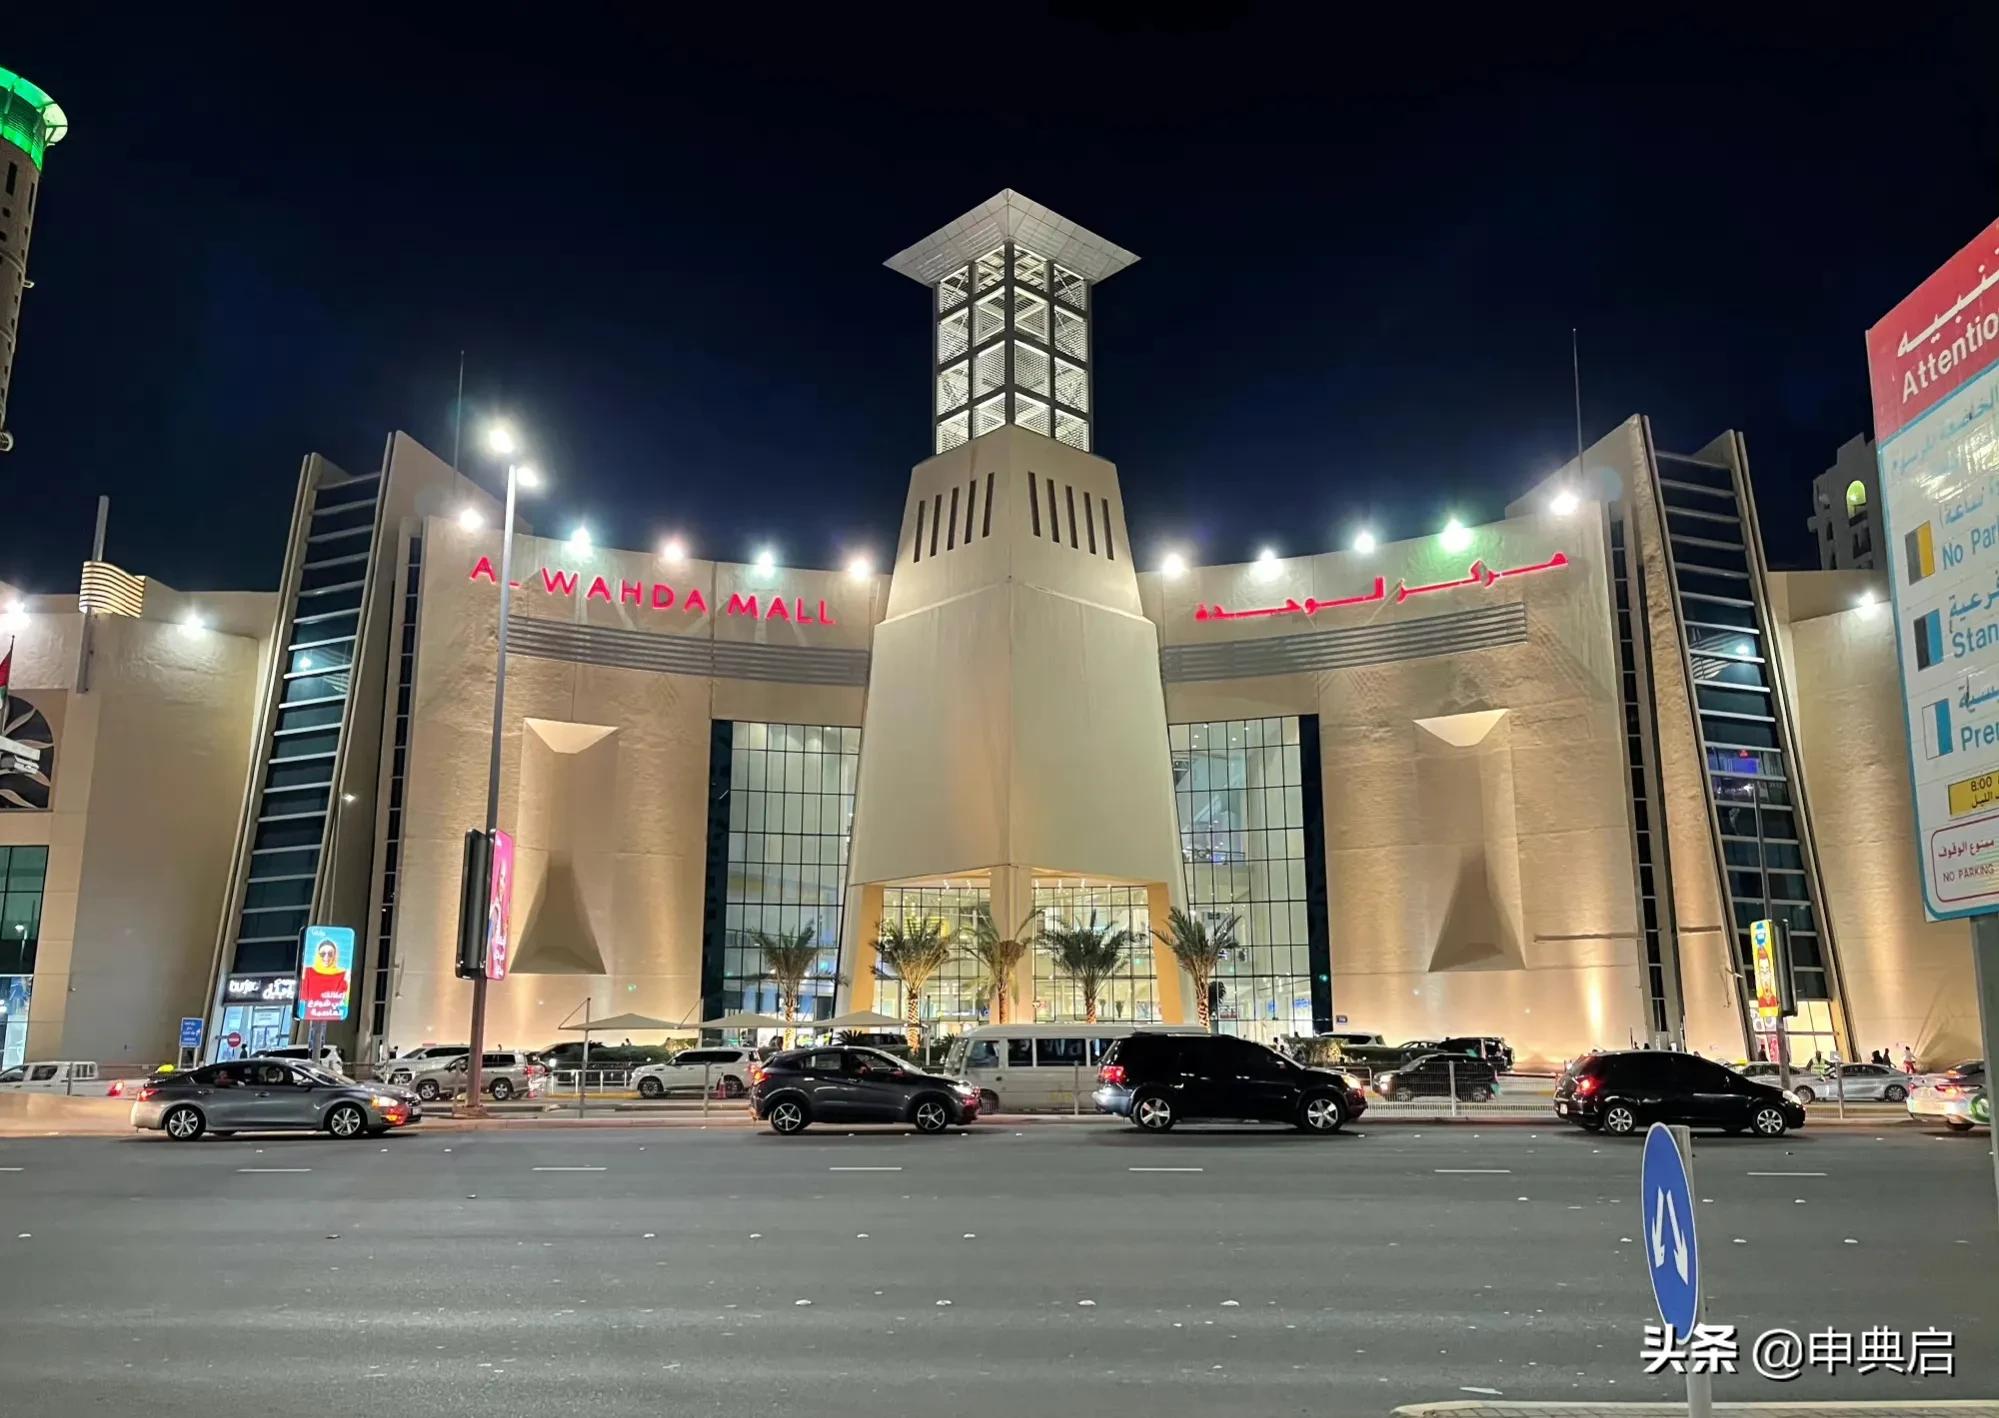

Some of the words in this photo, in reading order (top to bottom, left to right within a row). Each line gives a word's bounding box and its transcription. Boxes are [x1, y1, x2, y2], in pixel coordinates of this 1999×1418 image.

[1902, 309, 1999, 403] Attentio
[1942, 541, 1963, 570] No
[1971, 515, 1999, 554] Par
[541, 567, 707, 614] WAHDA
[727, 592, 836, 625] MALL
[1961, 722, 1999, 751] Pre
[1971, 776, 1992, 791] 8:00
[1938, 841, 1967, 859] الوقوف
[1970, 840, 1994, 856] ممنوع
[1943, 871, 1955, 883] NO
[1958, 865, 1994, 880] PARKING
